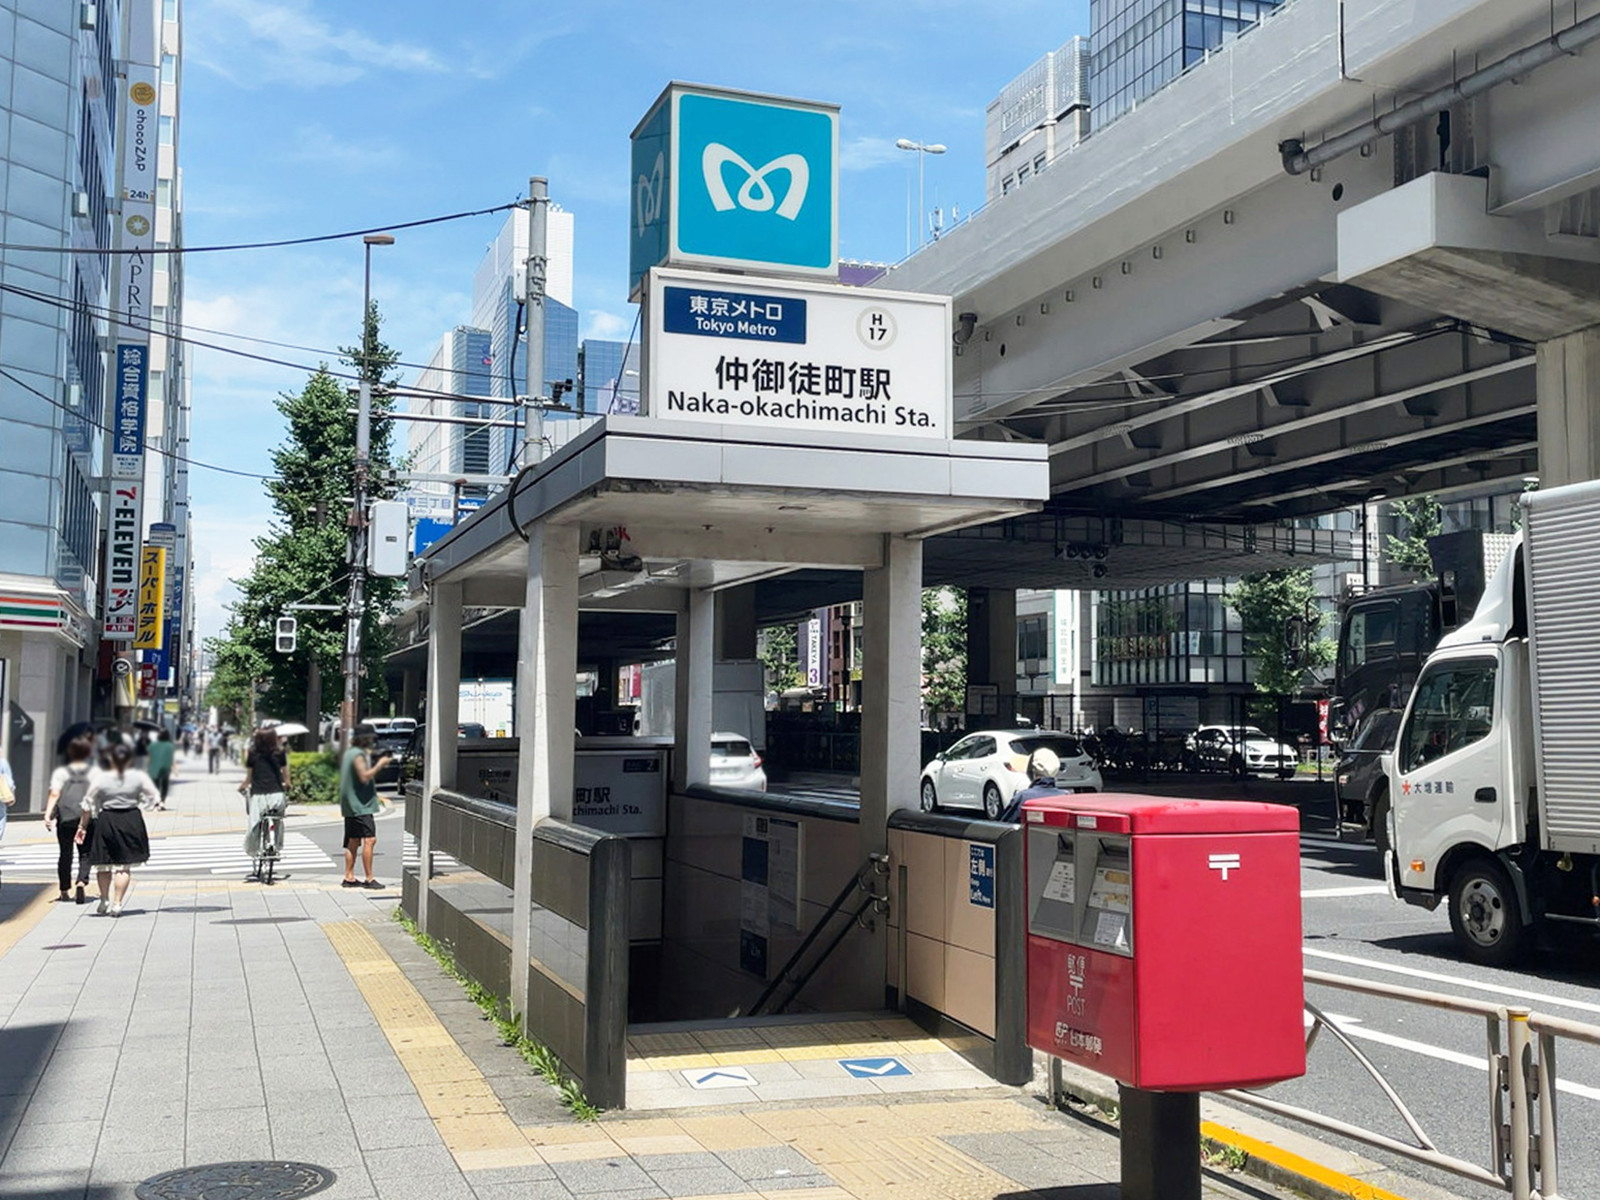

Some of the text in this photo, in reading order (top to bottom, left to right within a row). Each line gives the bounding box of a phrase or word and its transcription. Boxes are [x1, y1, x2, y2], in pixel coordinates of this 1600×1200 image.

[136, 108, 147, 171] chocoZAP
[130, 190, 149, 200] 24h
[689, 295, 783, 321] 東京メトロ
[695, 316, 777, 336] Tokyo Metro
[872, 313, 882, 326] H
[869, 327, 887, 341] 17
[715, 356, 892, 401] 仲御徒町駅
[120, 348, 142, 452] 総合資格学院
[667, 390, 887, 424] Naka-okachimachi
[894, 406, 937, 428] Sta.
[137, 552, 159, 643] スーパーホテル
[111, 624, 129, 632] ATM
[810, 668, 818, 684] 3
[622, 804, 643, 815] Sta.
[1067, 994, 1085, 1017] POST
